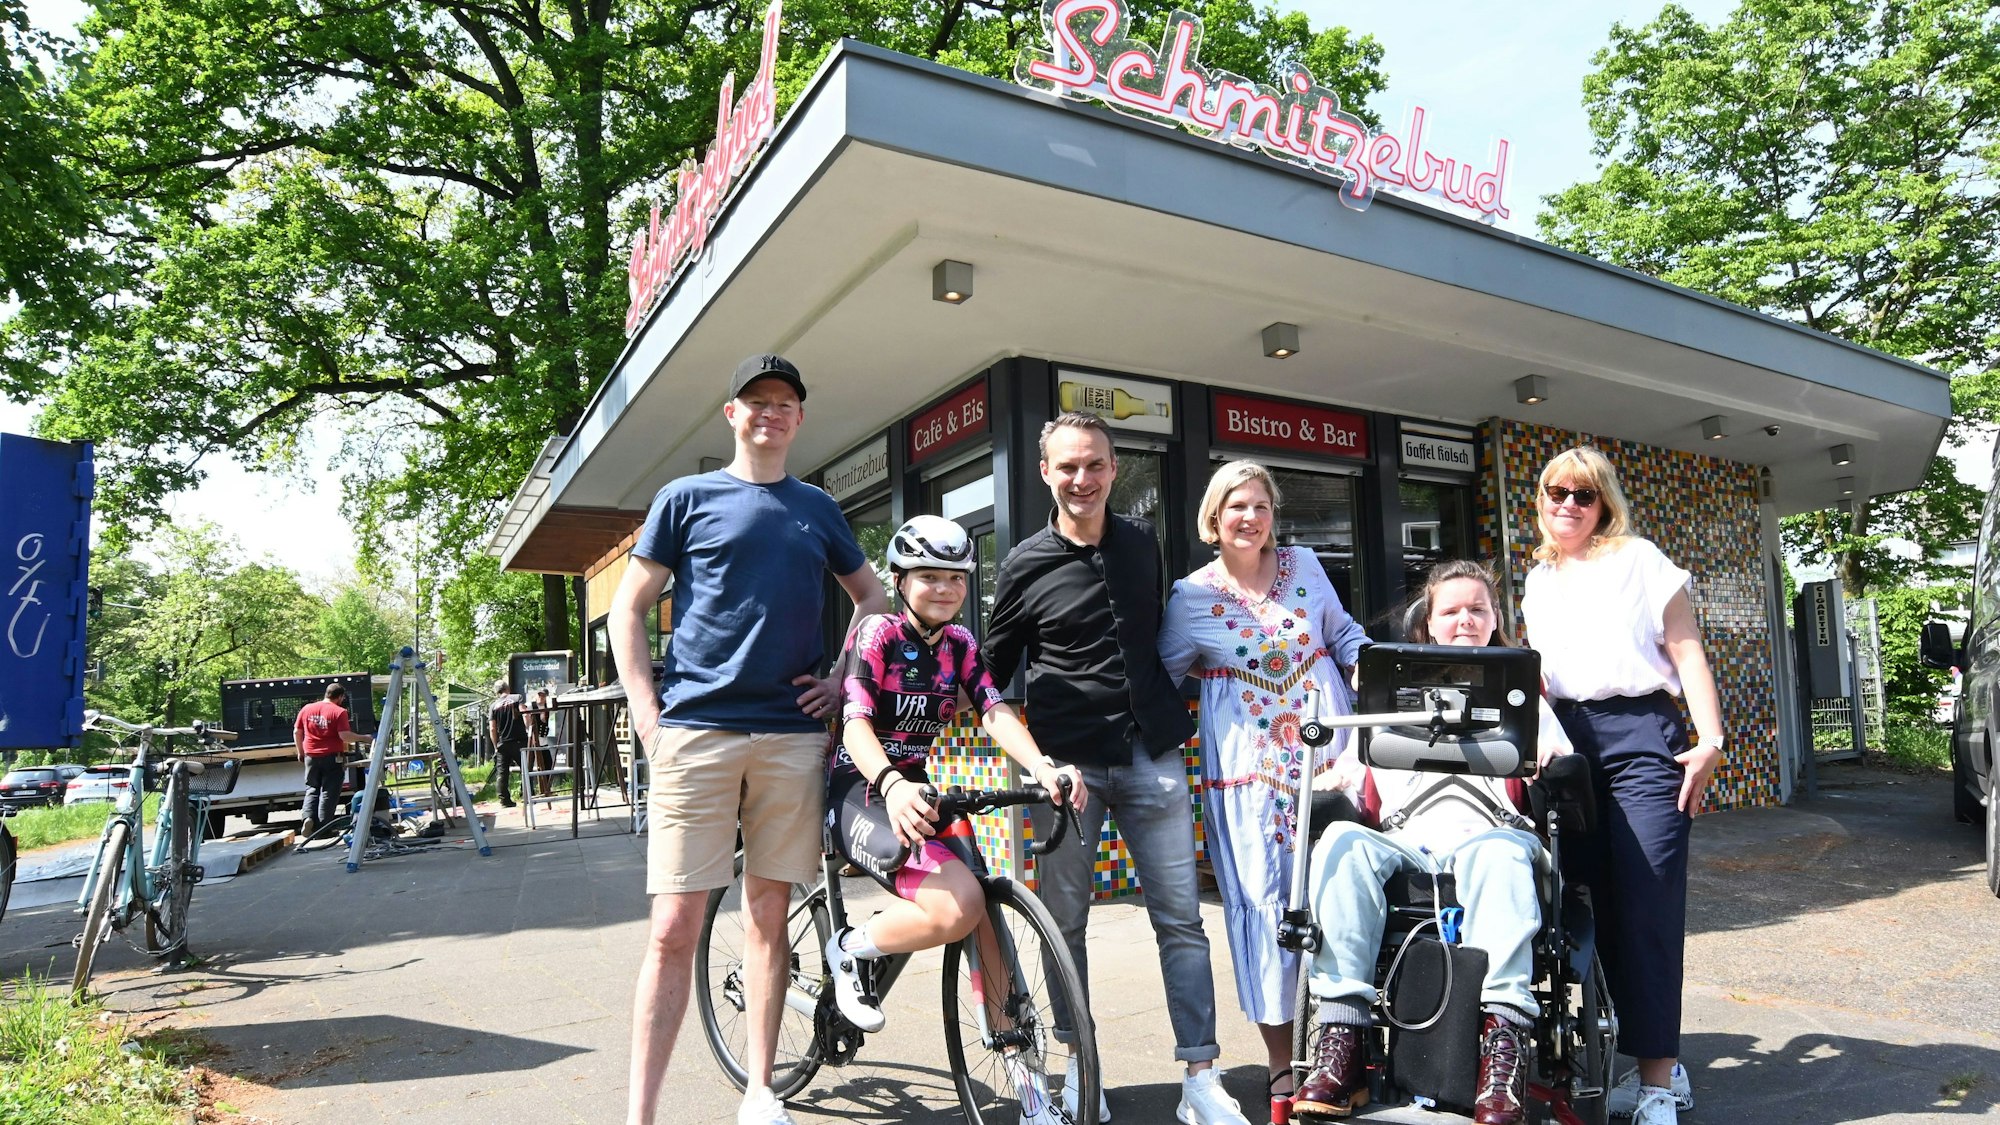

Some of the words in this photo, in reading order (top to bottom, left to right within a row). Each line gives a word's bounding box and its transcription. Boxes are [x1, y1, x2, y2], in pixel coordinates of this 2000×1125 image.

[1029, 0, 1509, 219] Schmitzebud
[1095, 388, 1104, 409] FASS
[914, 417, 943, 452] Café
[947, 411, 958, 434] &
[962, 398, 984, 427] Eis
[1227, 409, 1292, 439] Bistro
[1299, 418, 1316, 442] &
[1323, 423, 1357, 447] Bar
[1405, 441, 1434, 460] Gaffel
[1437, 445, 1469, 465] Kölsch
[1816, 586, 1828, 645] CIGARETTEN
[895, 694, 927, 720] VfR
[850, 813, 875, 847] VfR
